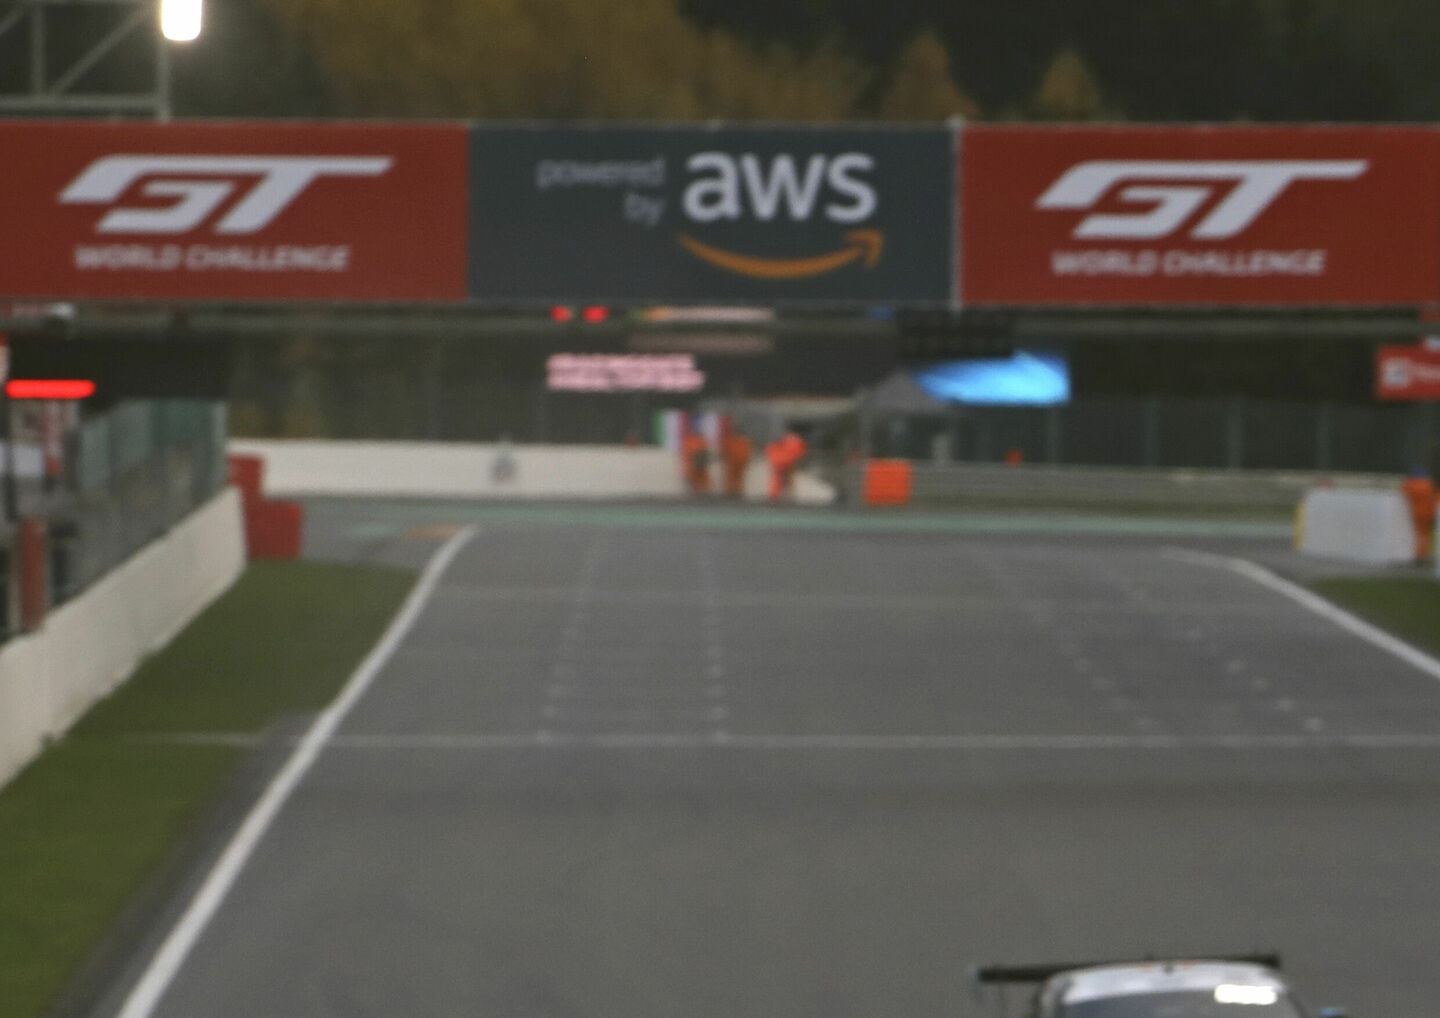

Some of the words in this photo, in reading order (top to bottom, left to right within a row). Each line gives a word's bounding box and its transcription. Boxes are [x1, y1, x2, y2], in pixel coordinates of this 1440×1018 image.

[534, 156, 667, 190] powered
[683, 151, 878, 222] aws
[58, 154, 395, 233] GT
[624, 191, 665, 229] by
[1035, 159, 1369, 239] GT
[74, 244, 181, 271] WORLD
[185, 244, 349, 271] CHALLENGE
[1053, 249, 1157, 277] WORLD
[1161, 249, 1328, 277] CHALLENGE
